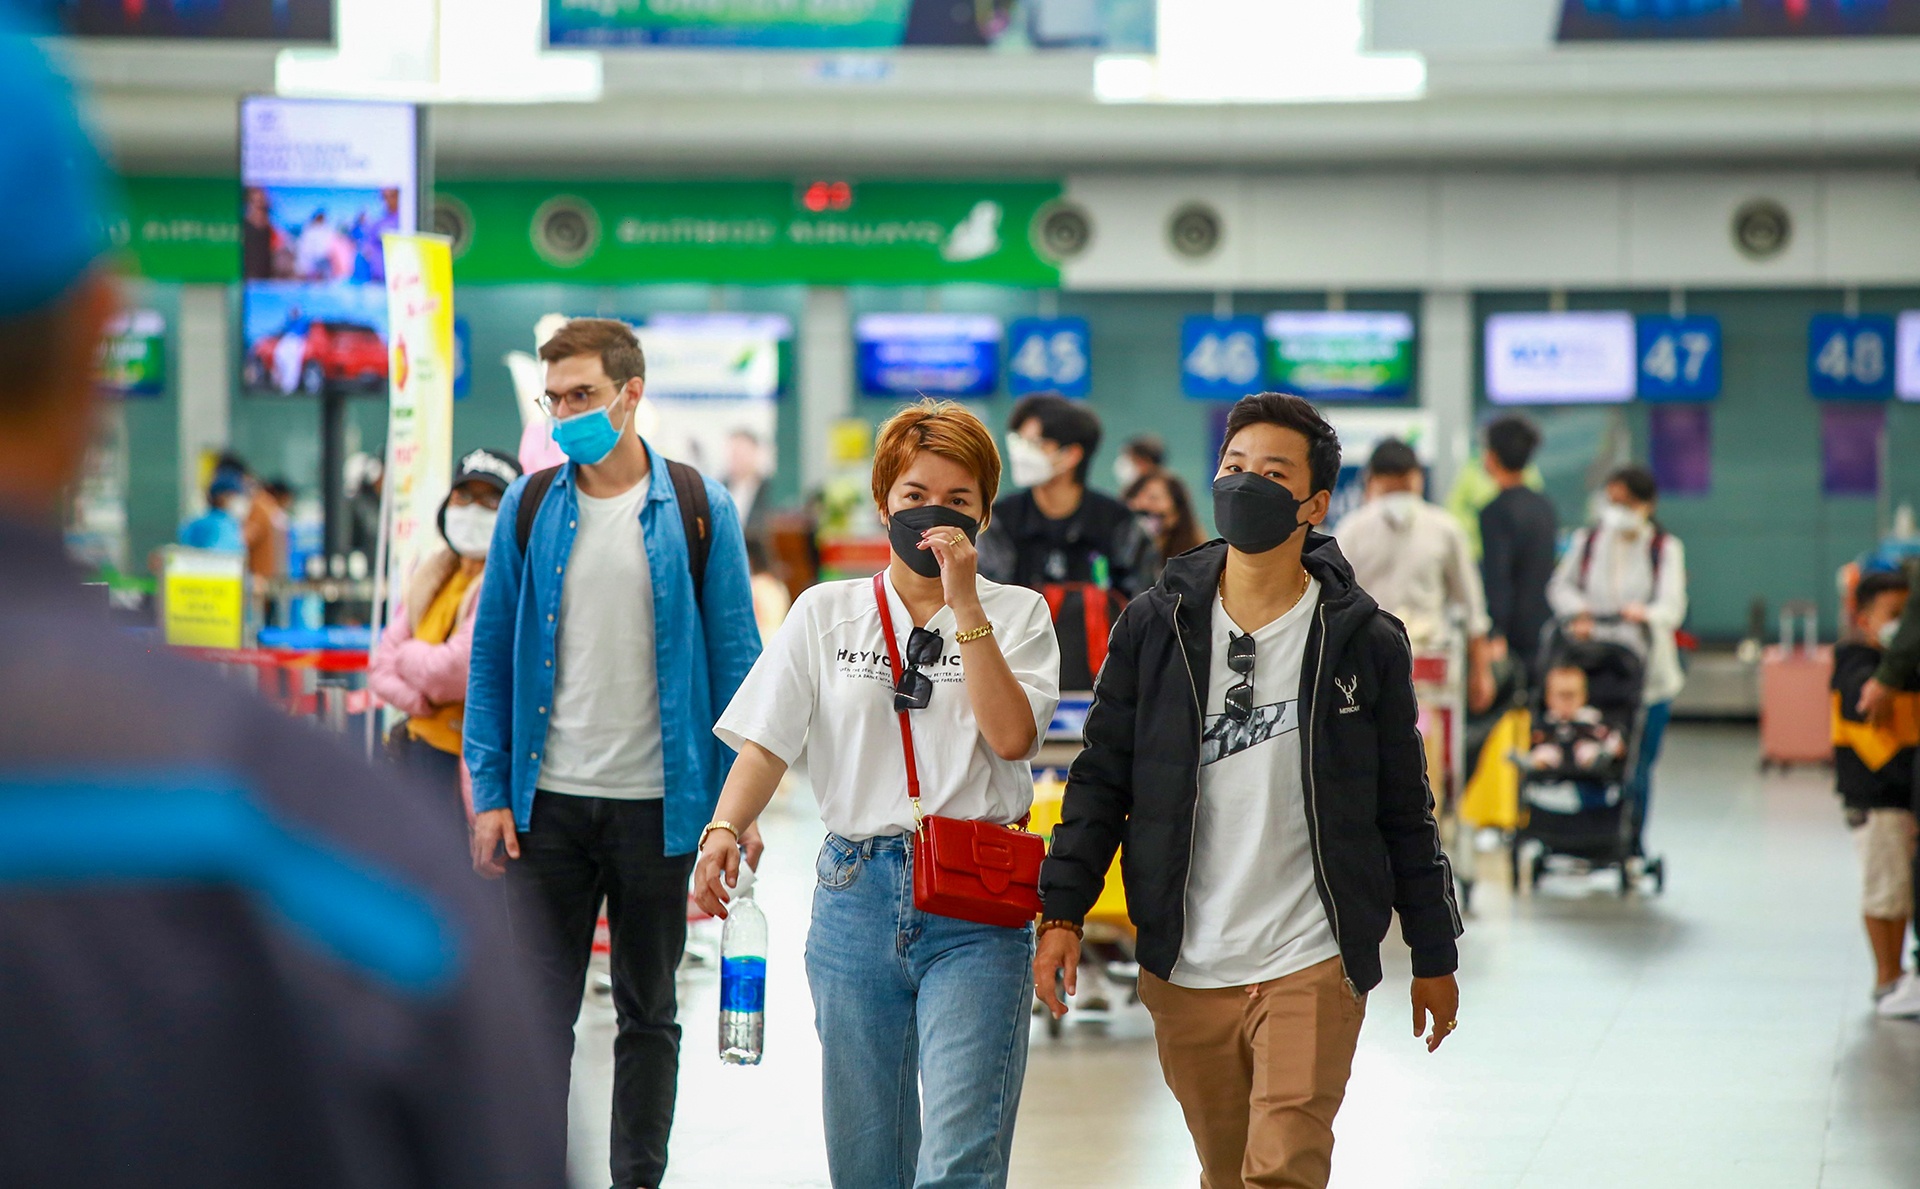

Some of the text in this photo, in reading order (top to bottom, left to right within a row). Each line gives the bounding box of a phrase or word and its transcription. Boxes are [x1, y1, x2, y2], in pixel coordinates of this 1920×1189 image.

[1011, 332, 1087, 384] 45
[1184, 332, 1259, 384] 46
[1643, 331, 1711, 384] 47
[1816, 331, 1885, 384] 48
